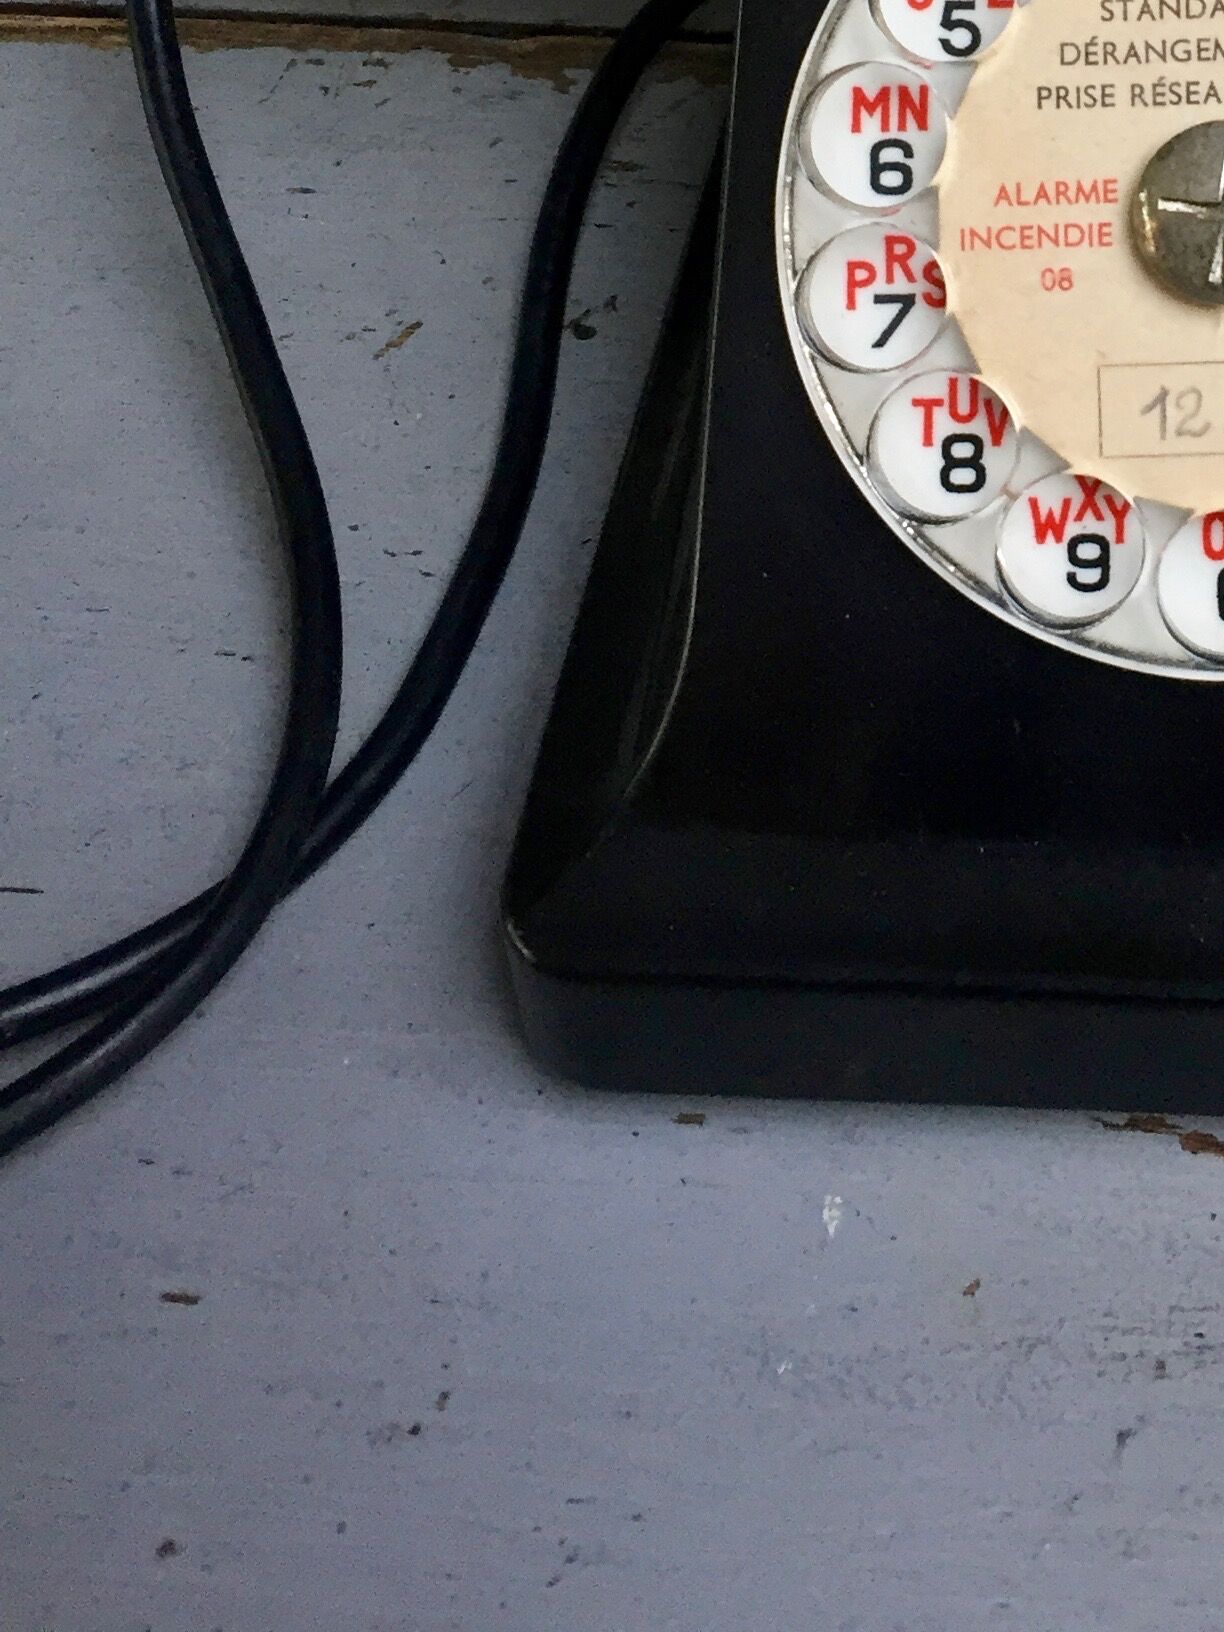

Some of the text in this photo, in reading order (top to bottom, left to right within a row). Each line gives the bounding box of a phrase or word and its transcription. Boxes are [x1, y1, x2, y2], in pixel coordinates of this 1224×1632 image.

[938, 0, 982, 58] 5
[850, 84, 929, 134] MN
[1036, 83, 1116, 111] PRISE
[869, 138, 915, 196] 6
[994, 177, 1118, 207] ALARME
[959, 220, 1112, 251] INCENDIE
[1039, 265, 1074, 292] 08
[871, 293, 917, 349] 7
[939, 432, 987, 494] 8
[1027, 474, 1131, 545] WXY
[1066, 533, 1111, 593] 9
